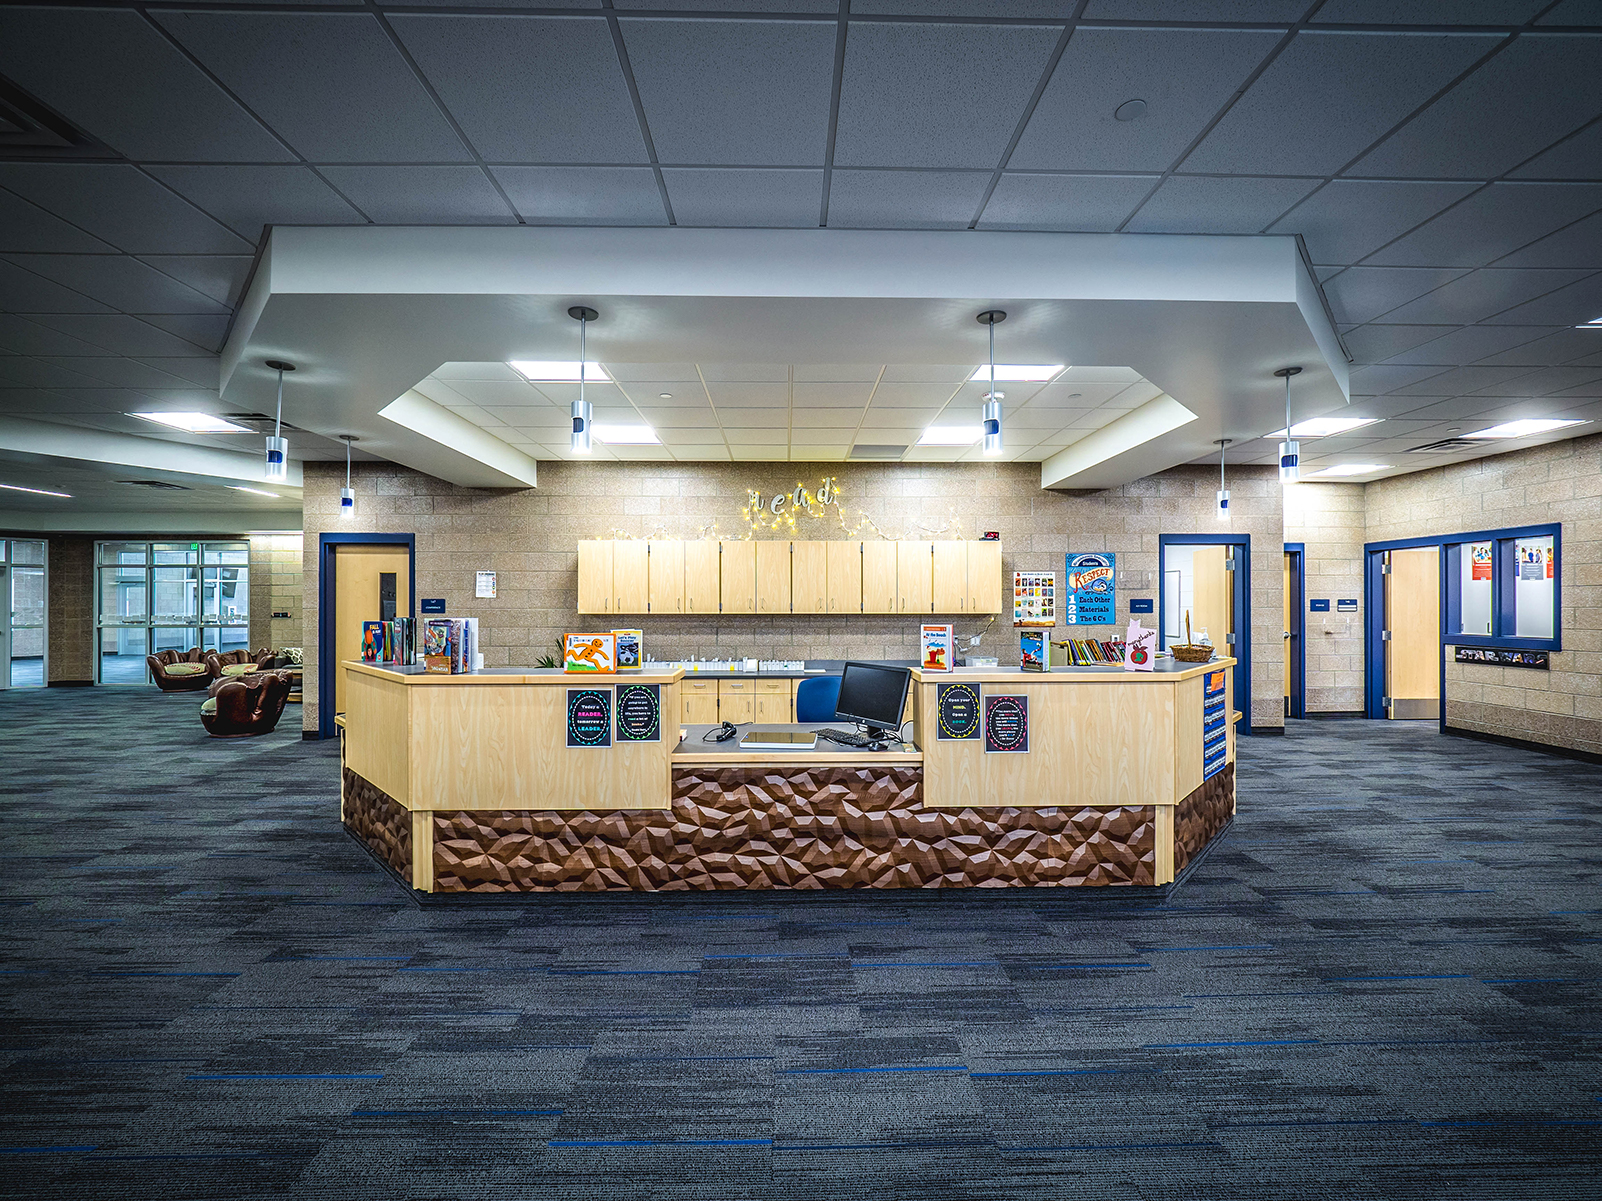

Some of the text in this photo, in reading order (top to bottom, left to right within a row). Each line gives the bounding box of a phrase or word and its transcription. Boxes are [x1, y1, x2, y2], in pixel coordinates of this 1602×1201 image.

[749, 477, 834, 515] read
[1073, 568, 1110, 593] RESPECT
[1068, 594, 1077, 604] 1
[1068, 604, 1077, 614] 2
[1068, 614, 1077, 624] 3
[1456, 648, 1500, 663] STAR
